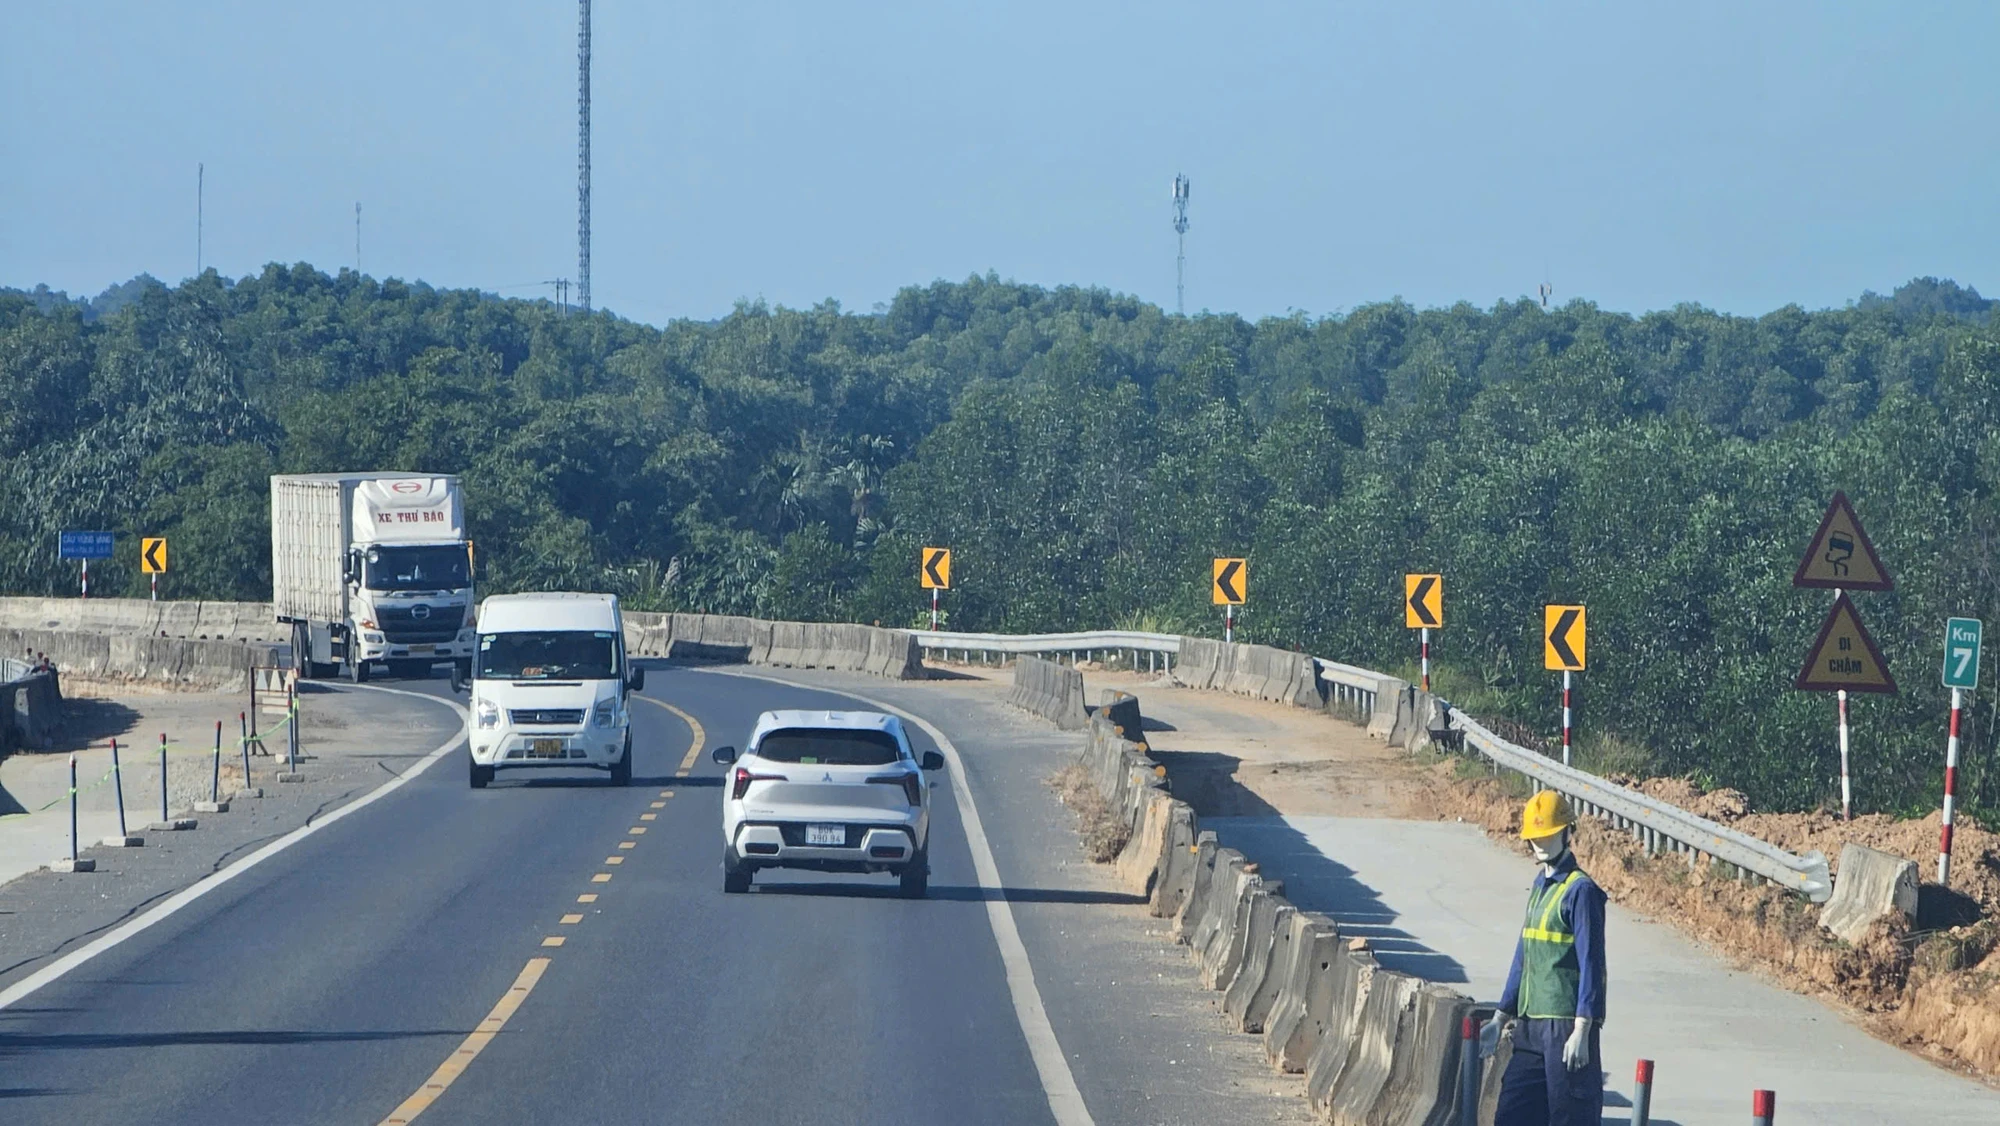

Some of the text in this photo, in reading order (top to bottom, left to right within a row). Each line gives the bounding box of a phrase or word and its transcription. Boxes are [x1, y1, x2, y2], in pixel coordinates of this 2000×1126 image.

[377, 512, 393, 523] XE
[1952, 627, 1977, 643] Km
[1829, 656, 1862, 676] CHẬM
[1953, 647, 1973, 679] 7
